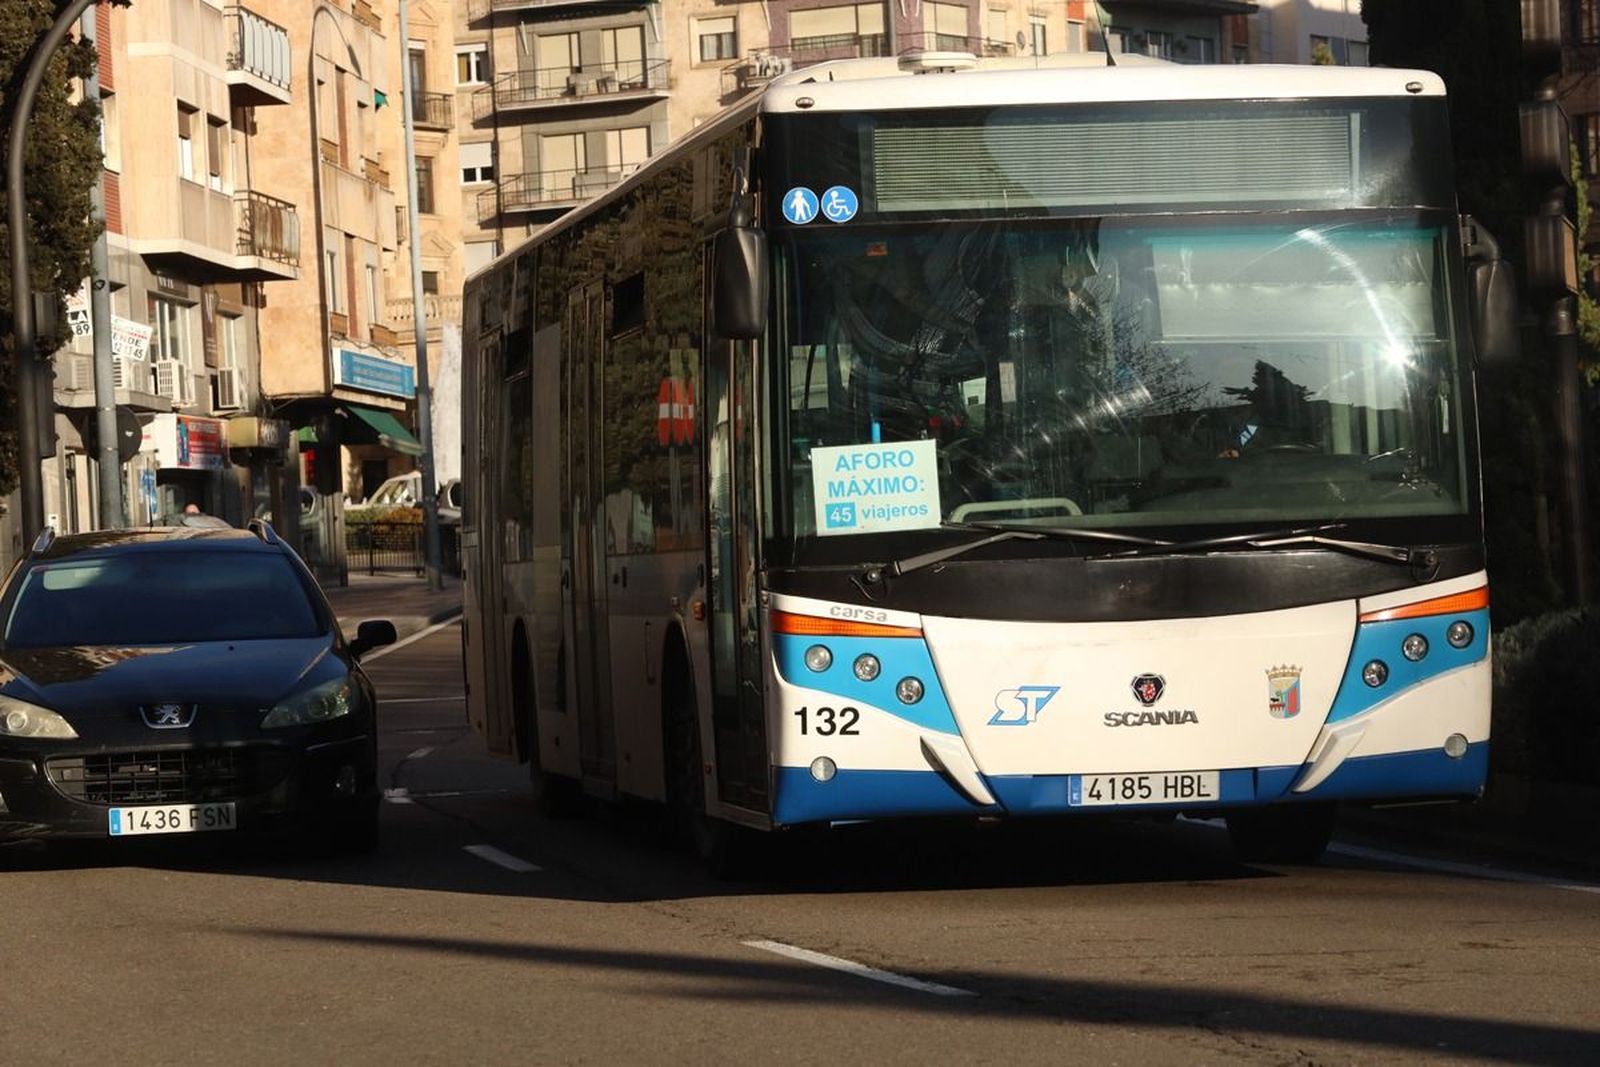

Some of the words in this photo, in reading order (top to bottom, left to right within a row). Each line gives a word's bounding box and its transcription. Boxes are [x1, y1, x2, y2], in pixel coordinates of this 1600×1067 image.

[835, 450, 914, 472] AFORO
[828, 475, 925, 498] MÁXIMO:
[830, 507, 851, 522] 45
[862, 504, 928, 521] viajeros
[830, 606, 887, 622] carsa
[794, 706, 860, 736] 132
[1104, 710, 1199, 727] SCANIA
[1088, 777, 1152, 800] 4185
[1163, 775, 1211, 798] HBL
[127, 809, 181, 831] 1436
[189, 806, 231, 828] FSN
